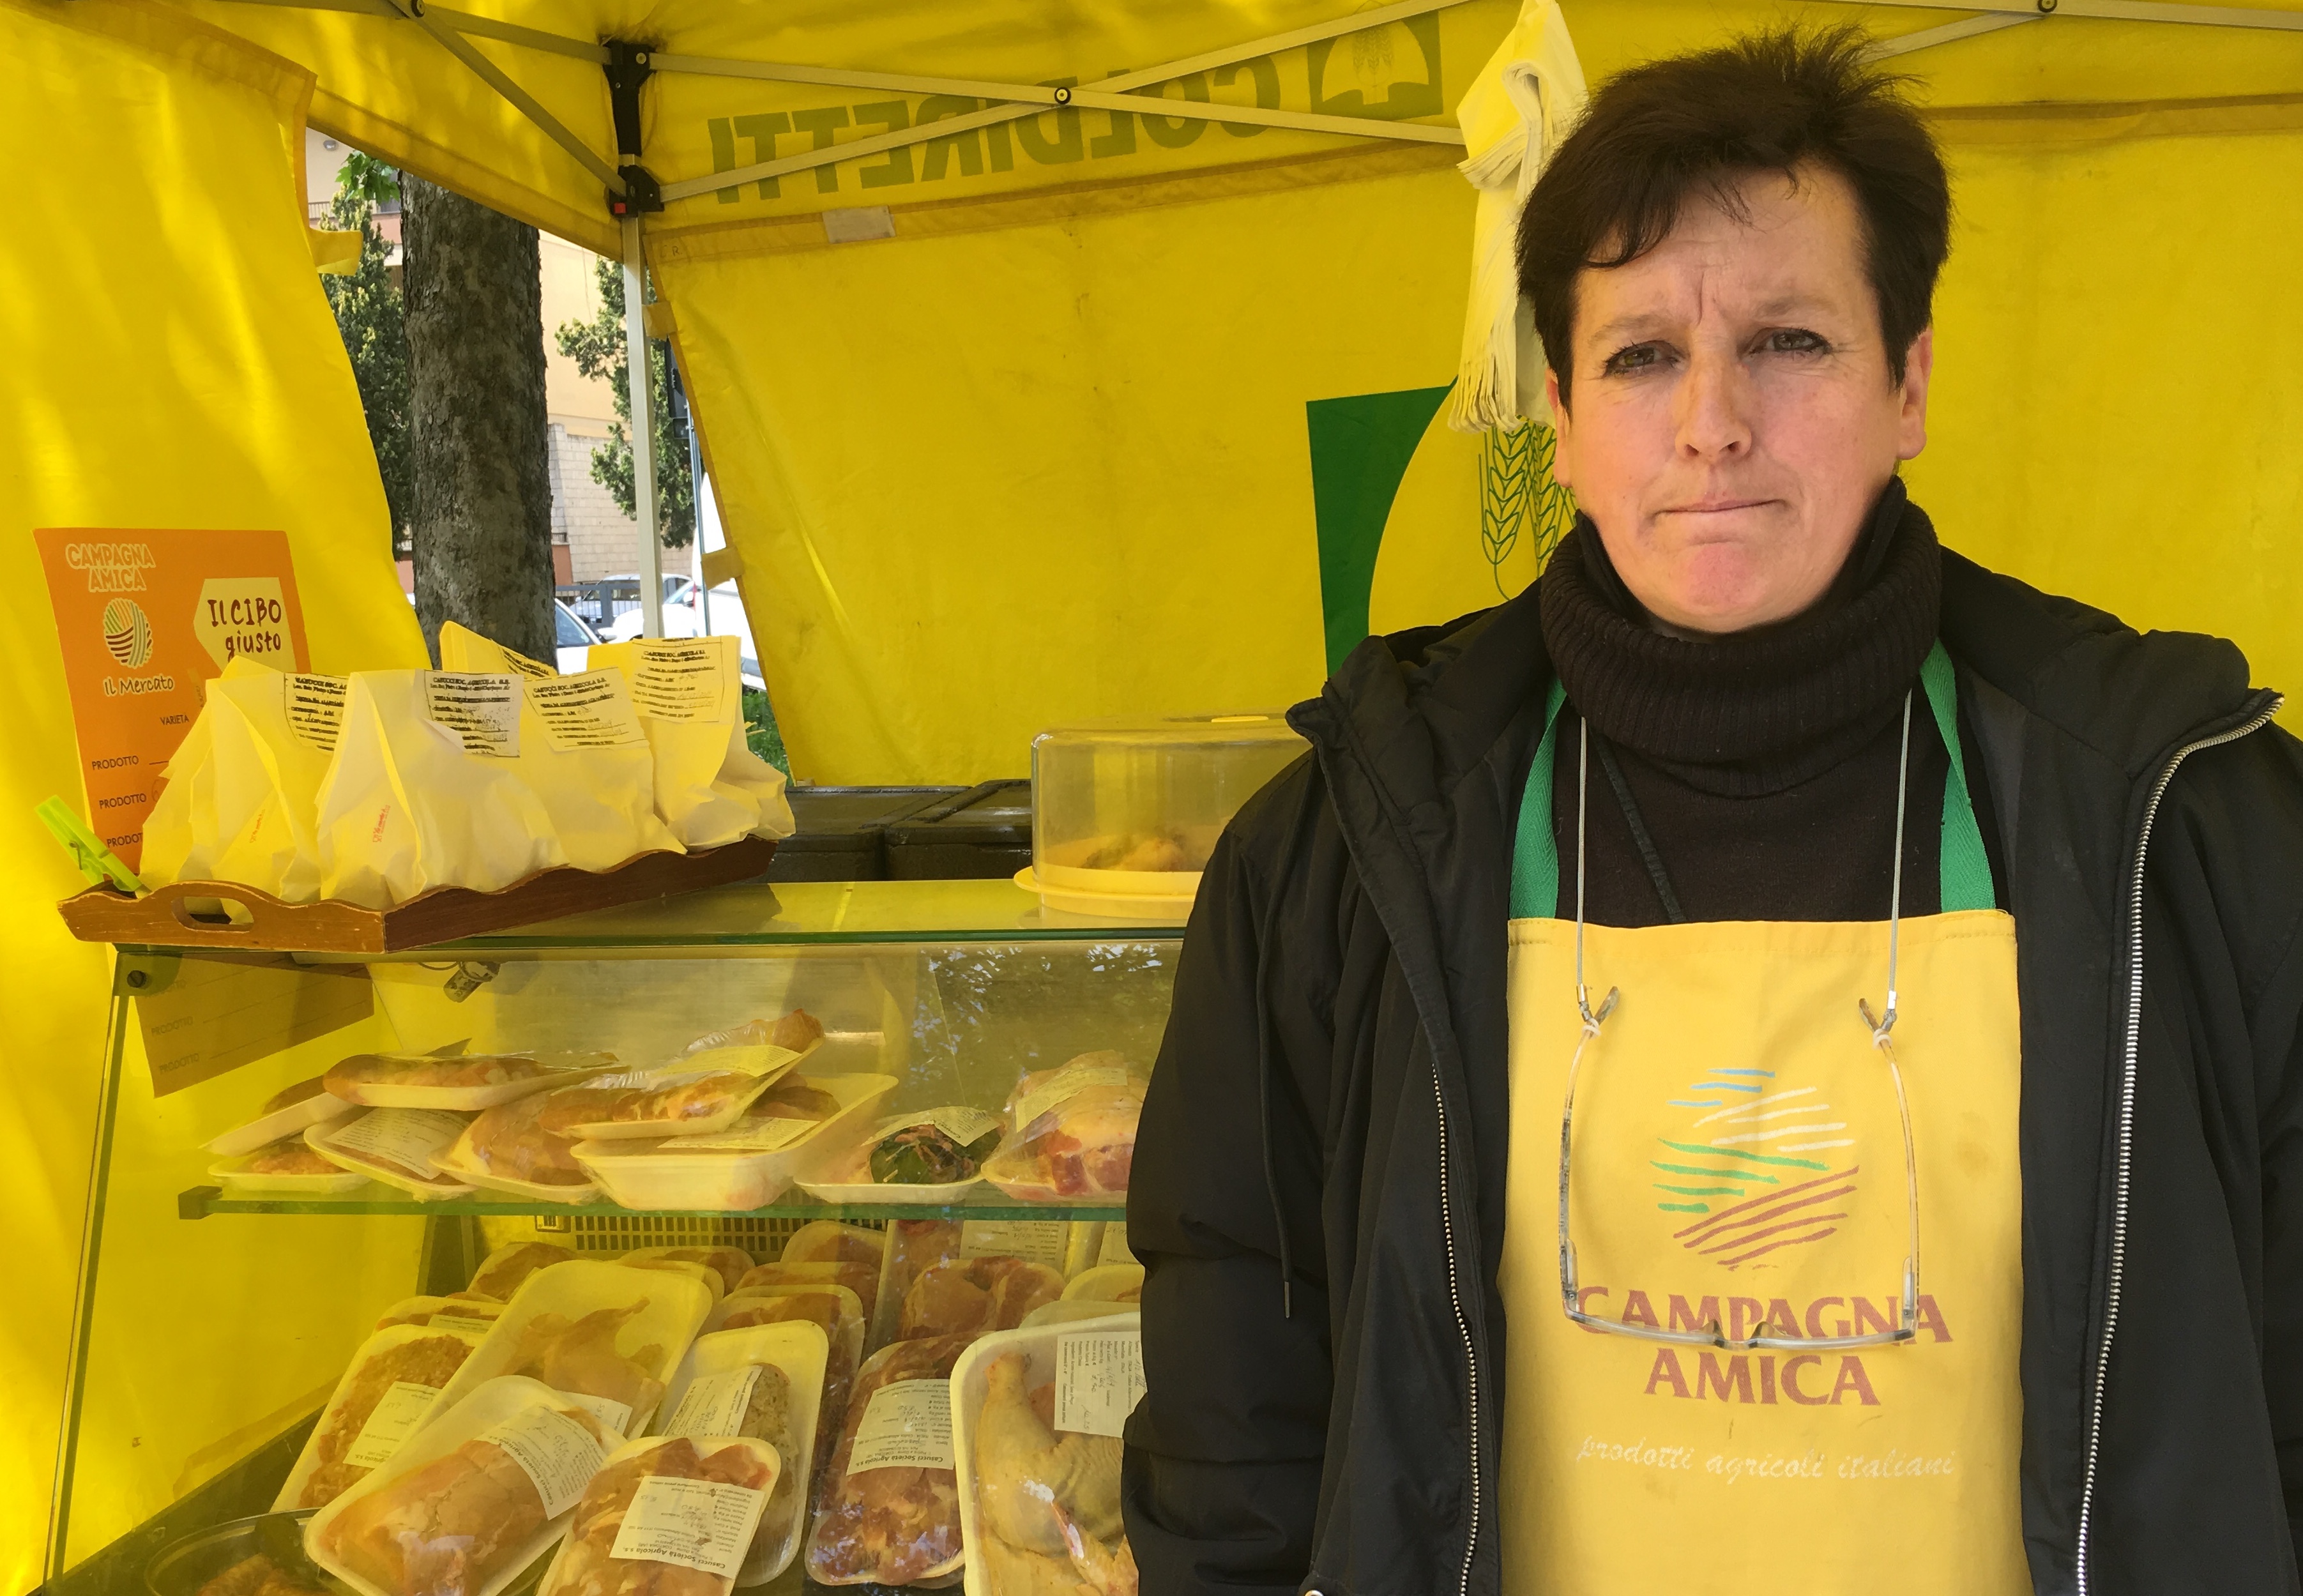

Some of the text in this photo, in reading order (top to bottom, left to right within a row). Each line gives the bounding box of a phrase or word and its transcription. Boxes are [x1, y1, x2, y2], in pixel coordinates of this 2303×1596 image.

[66, 543, 155, 568] CAMPAGNA
[89, 566, 146, 592] AMICA
[231, 597, 281, 627] CIBO
[225, 630, 281, 662] giusto
[103, 674, 174, 697] Il Mercato
[91, 755, 139, 770] PRODOTTO
[99, 793, 147, 809] PRODOTTO
[107, 832, 143, 848] PRODOT
[1577, 1285, 1953, 1344] CAMPAGNA
[1644, 1348, 1881, 1406] AMICA
[1576, 1435, 1956, 1485] prodotti agricoli italiani
[668, 1550, 696, 1562] Società
[697, 1559, 726, 1569] Casucci
